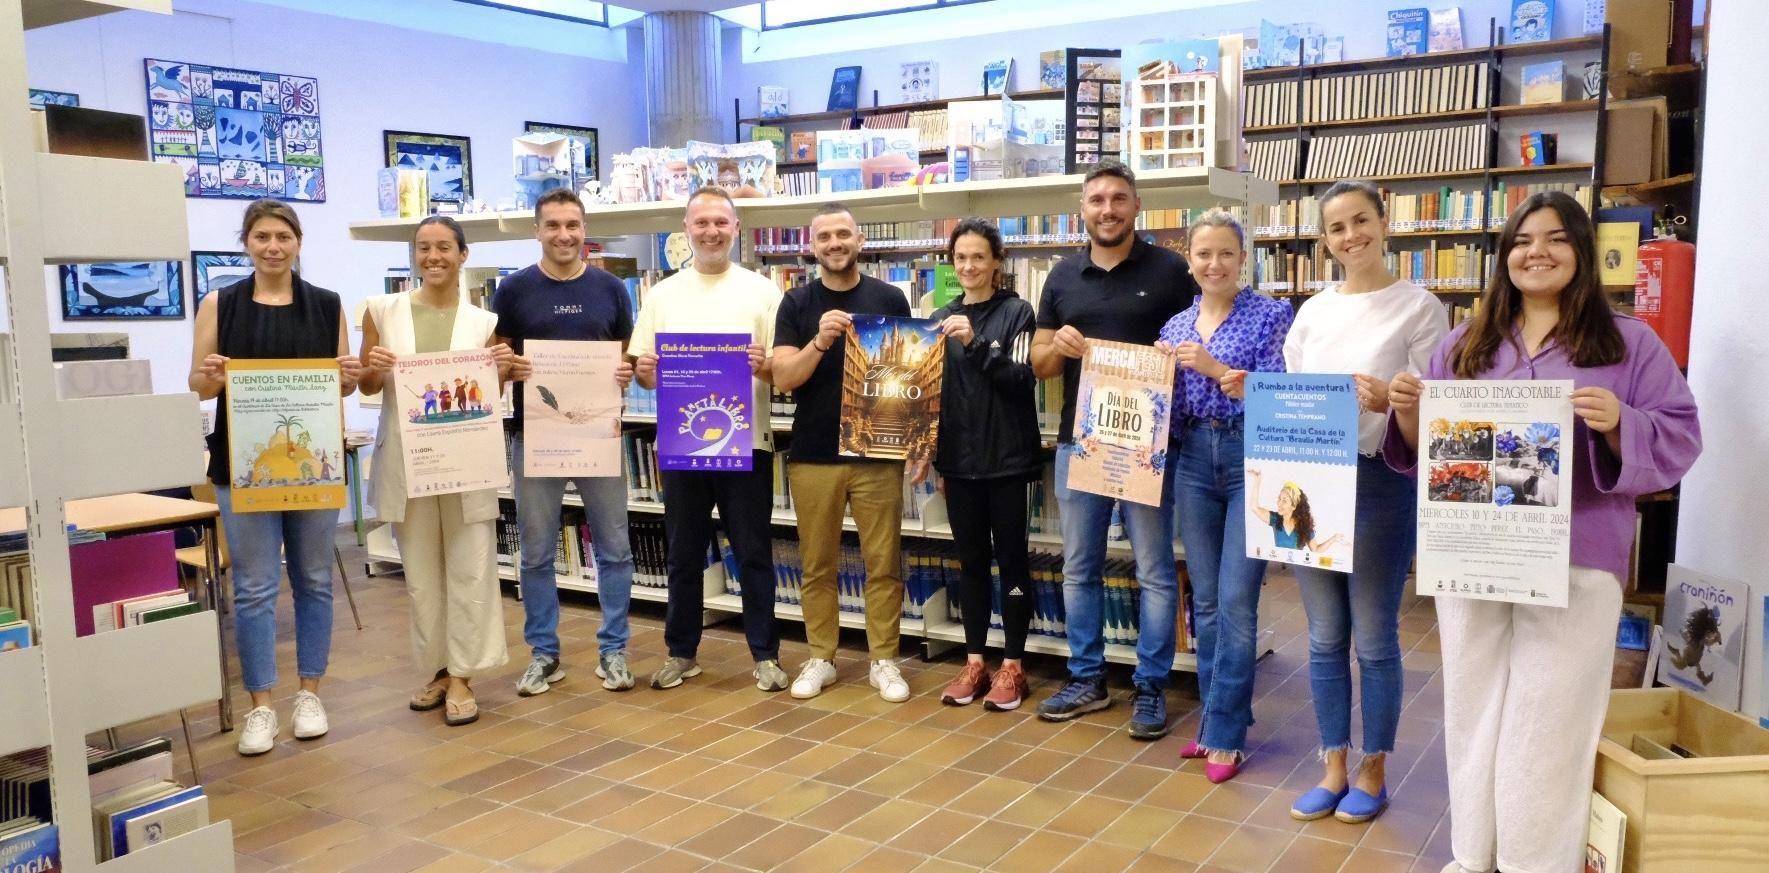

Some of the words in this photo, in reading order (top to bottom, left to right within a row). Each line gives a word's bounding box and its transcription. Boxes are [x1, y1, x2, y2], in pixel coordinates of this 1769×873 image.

[660, 343, 678, 352] Club
[679, 344, 688, 352] de
[690, 344, 716, 352] lectura
[398, 359, 434, 368] TESOROS
[452, 353, 494, 364] CORAZÓN
[232, 376, 274, 385] CUENTOS
[277, 376, 290, 384] EN
[292, 374, 336, 384] FAMILIA
[861, 382, 922, 400] LIBRO
[1258, 381, 1286, 390] Rumbo
[1295, 382, 1303, 391] la
[1305, 383, 1344, 392] aventura
[1430, 387, 1440, 399] EL
[1444, 386, 1488, 399] CUARTO
[1492, 386, 1562, 399] INAGOTABLE
[1108, 391, 1120, 407] DÍA
[1124, 396, 1139, 410] DEL
[678, 398, 716, 434] PLANETA
[1098, 403, 1142, 432] LIBRO
[1257, 425, 1288, 434] Auditorio
[1290, 426, 1298, 434] de
[1301, 426, 1307, 434] la
[1308, 428, 1326, 436] Casa
[1339, 429, 1346, 437] la
[1258, 434, 1284, 442] Cultura
[1254, 444, 1260, 452] 22
[1266, 445, 1273, 453] 23
[1472, 510, 1480, 520] 10
[1483, 510, 1489, 520] Y
[1493, 511, 1502, 521] 24
[1505, 511, 1518, 522] DE
[1550, 514, 1569, 525] 2024
